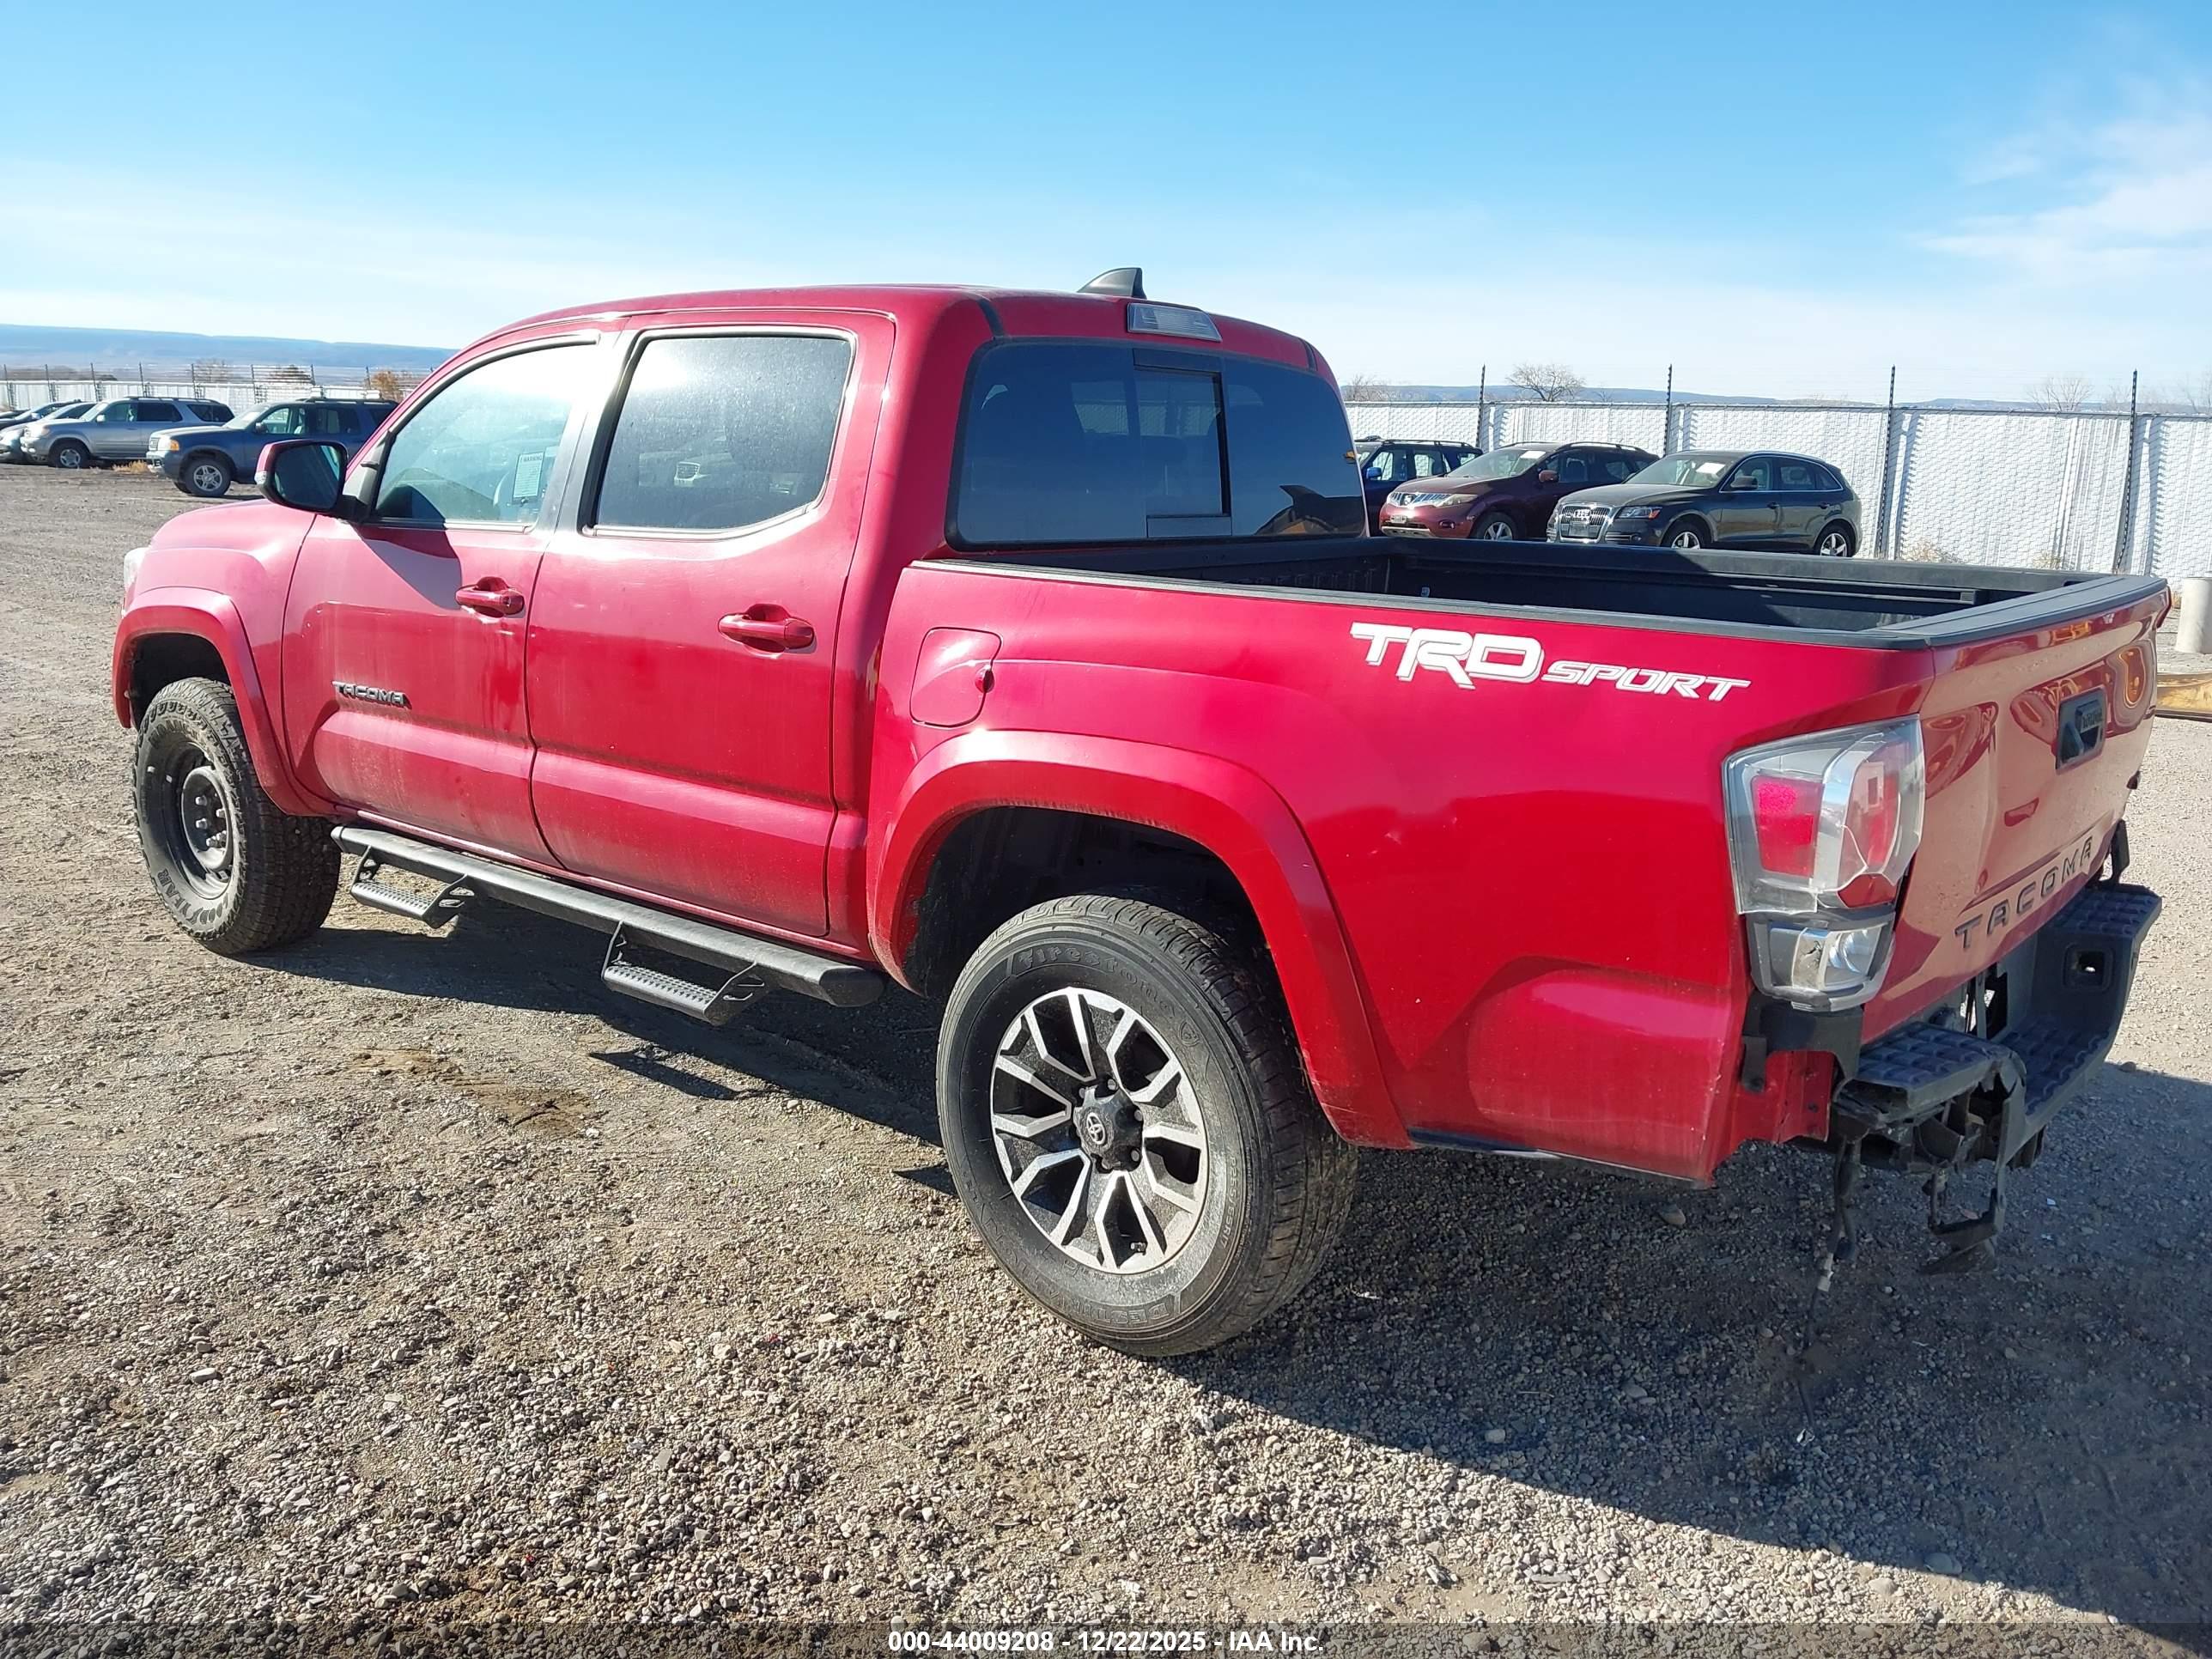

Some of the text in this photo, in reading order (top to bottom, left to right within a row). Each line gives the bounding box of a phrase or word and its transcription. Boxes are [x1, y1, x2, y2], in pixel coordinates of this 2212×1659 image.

[331, 680, 404, 707] TACOMA
[1350, 622, 1752, 702] TRD SPORT
[1954, 836, 2094, 949] TACOMA
[1018, 946, 1176, 1018] Firestone
